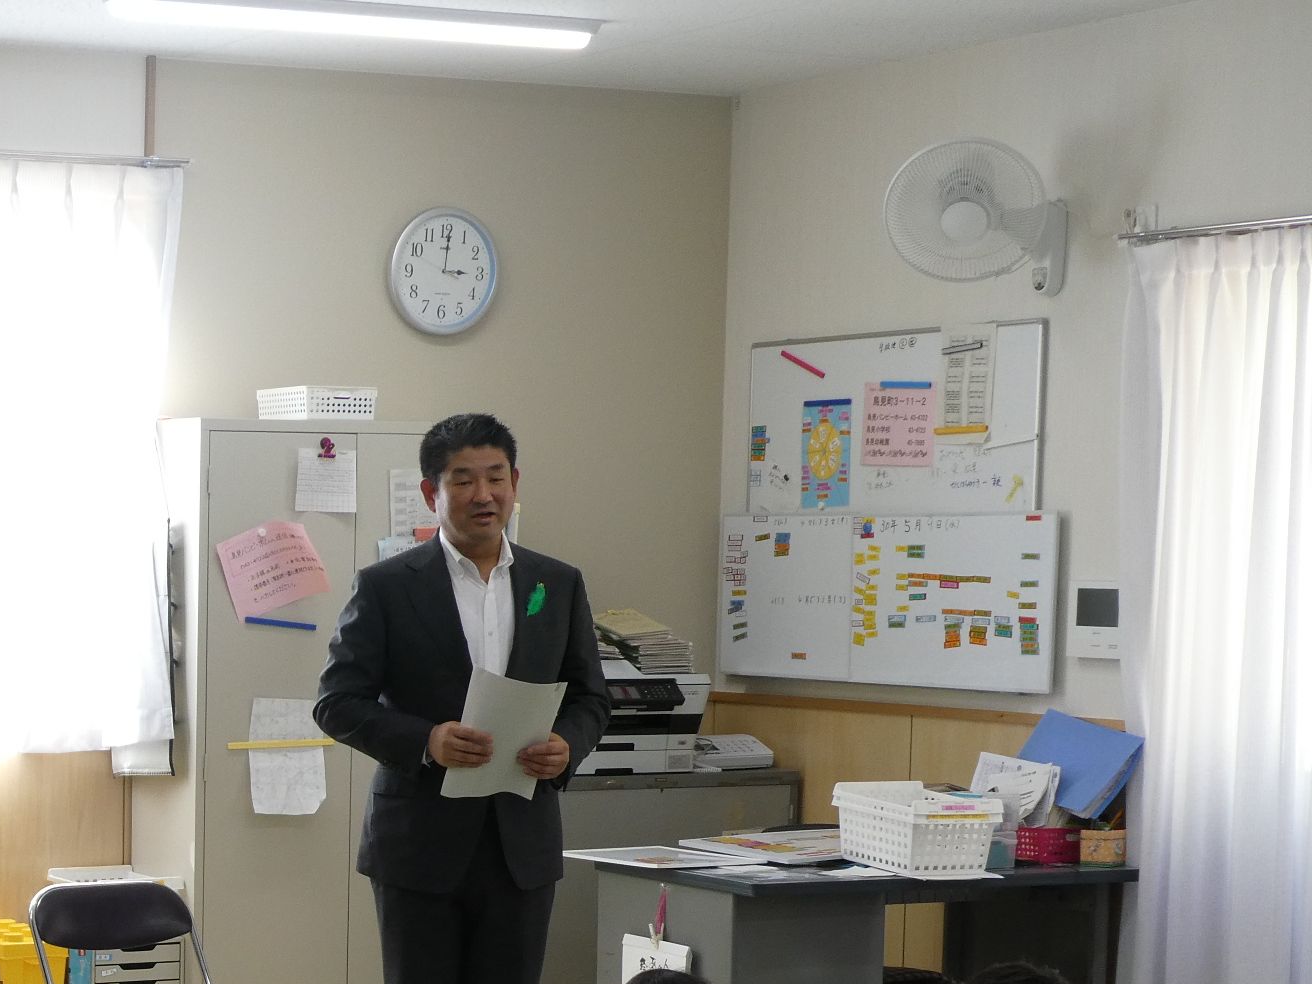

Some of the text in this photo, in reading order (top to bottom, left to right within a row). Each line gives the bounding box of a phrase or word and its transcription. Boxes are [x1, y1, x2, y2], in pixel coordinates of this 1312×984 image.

[424, 228, 434, 242] 11
[440, 223, 453, 239] 12
[410, 242, 423, 257] 10
[472, 246, 479, 260] 2
[404, 263, 414, 278] 9
[475, 266, 484, 281] 3
[409, 284, 418, 298] 8
[468, 287, 476, 300] 4
[421, 299, 430, 314] 7
[436, 304, 446, 319] 6
[455, 302, 463, 316] 5
